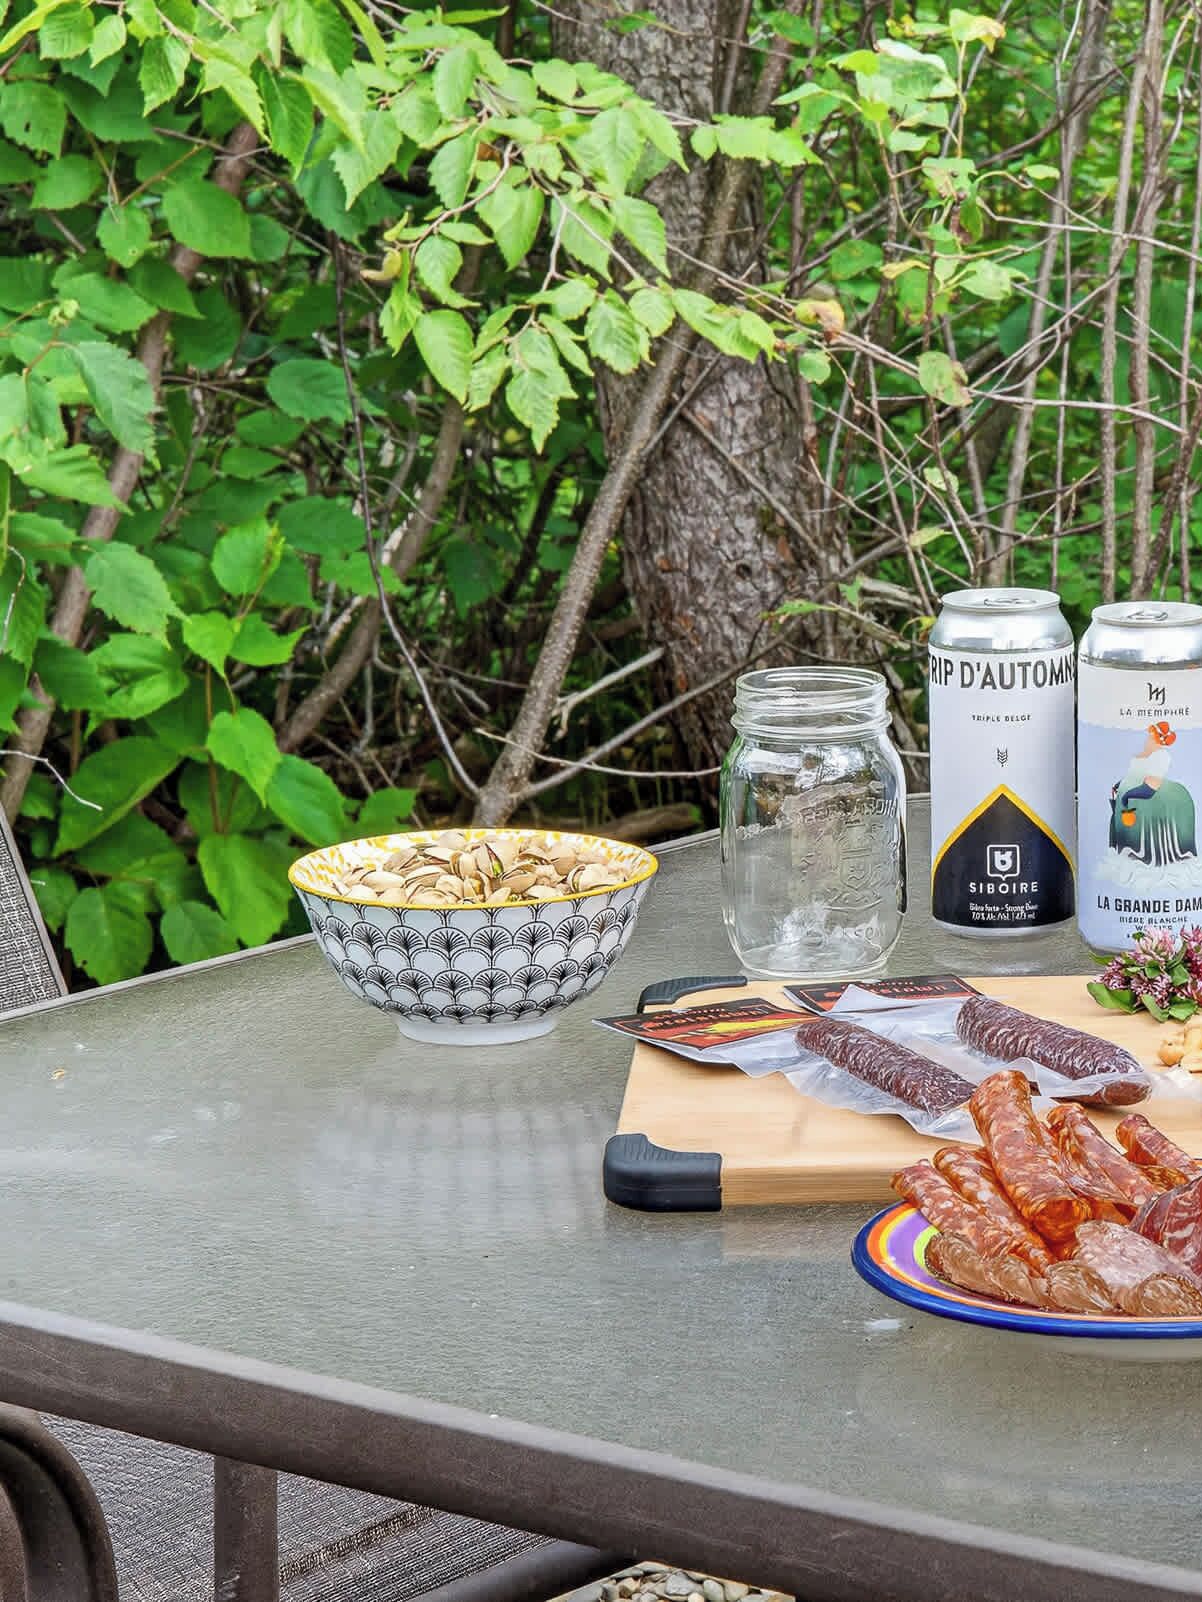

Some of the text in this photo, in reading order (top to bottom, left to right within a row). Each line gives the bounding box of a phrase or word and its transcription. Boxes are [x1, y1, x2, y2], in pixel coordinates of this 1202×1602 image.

[928, 652, 954, 686] RIP
[1120, 708, 1132, 716] LA
[969, 881, 1039, 894] SIBOIRE
[1097, 895, 1110, 911] LA
[1114, 898, 1170, 913] GRANDE
